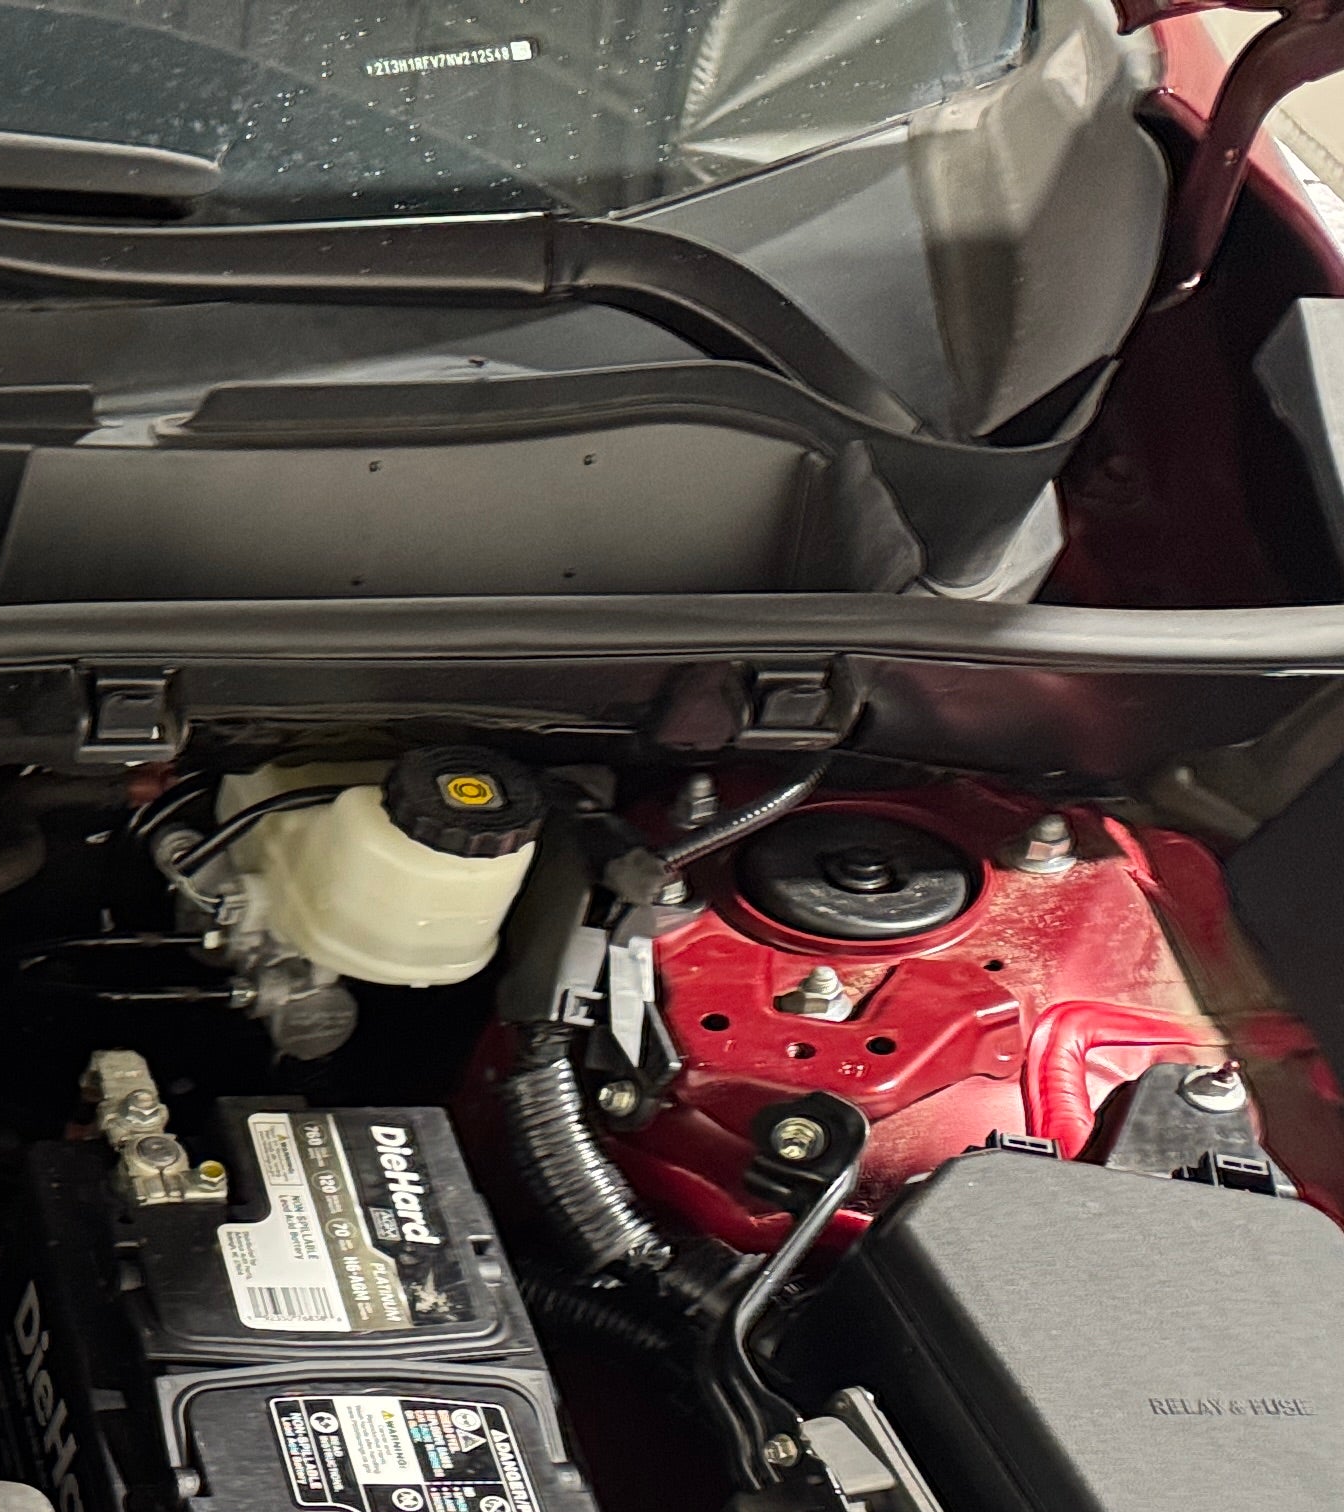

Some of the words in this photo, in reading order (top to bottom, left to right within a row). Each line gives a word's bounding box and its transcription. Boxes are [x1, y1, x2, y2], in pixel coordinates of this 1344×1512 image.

[302, 1125, 323, 1145] 760
[317, 1174, 338, 1193] 120
[367, 1125, 445, 1243] DieHard
[332, 1223, 350, 1236] 70
[368, 1262, 401, 1321] PLATINUM
[1148, 1397, 1224, 1416] RELAY
[1229, 1400, 1246, 1416] &
[1249, 1398, 1318, 1417] FUSE
